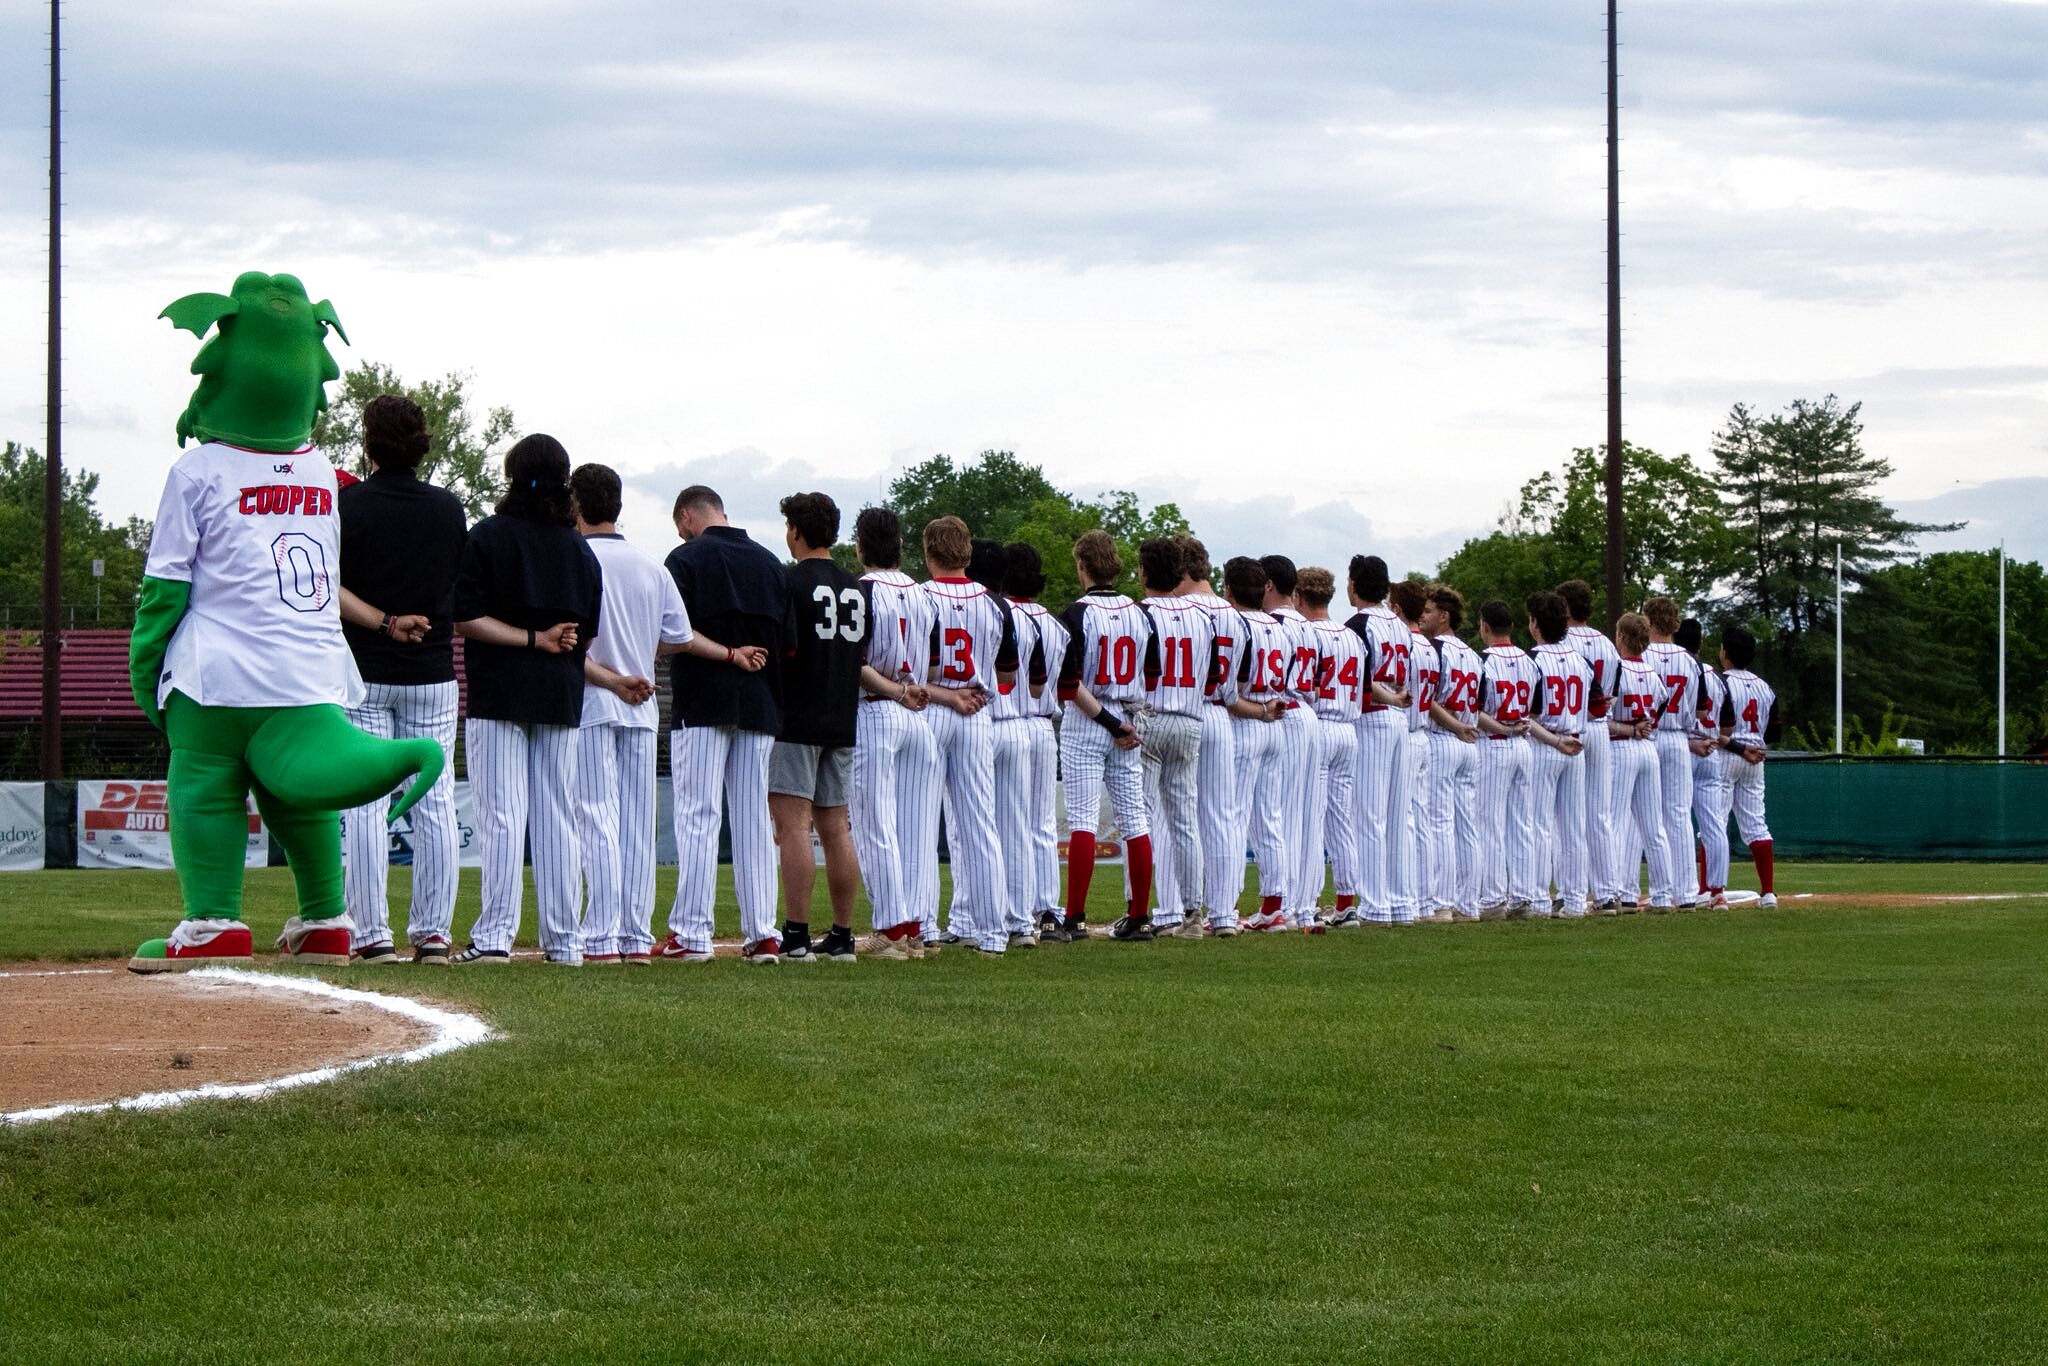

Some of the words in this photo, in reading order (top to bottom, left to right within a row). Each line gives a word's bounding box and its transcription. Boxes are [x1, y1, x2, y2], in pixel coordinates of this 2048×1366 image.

[239, 485, 332, 516] COOPER
[271, 533, 331, 612] 0
[813, 585, 866, 643] 33
[944, 628, 975, 681] 3
[1095, 636, 1136, 685] 10
[1162, 637, 1196, 687] 11
[1320, 656, 1358, 701] 24
[1547, 675, 1583, 716] 30
[1667, 675, 1687, 713] 7
[1496, 681, 1530, 721] 29
[1742, 699, 1759, 733] 4
[125, 814, 165, 830] AUTO
